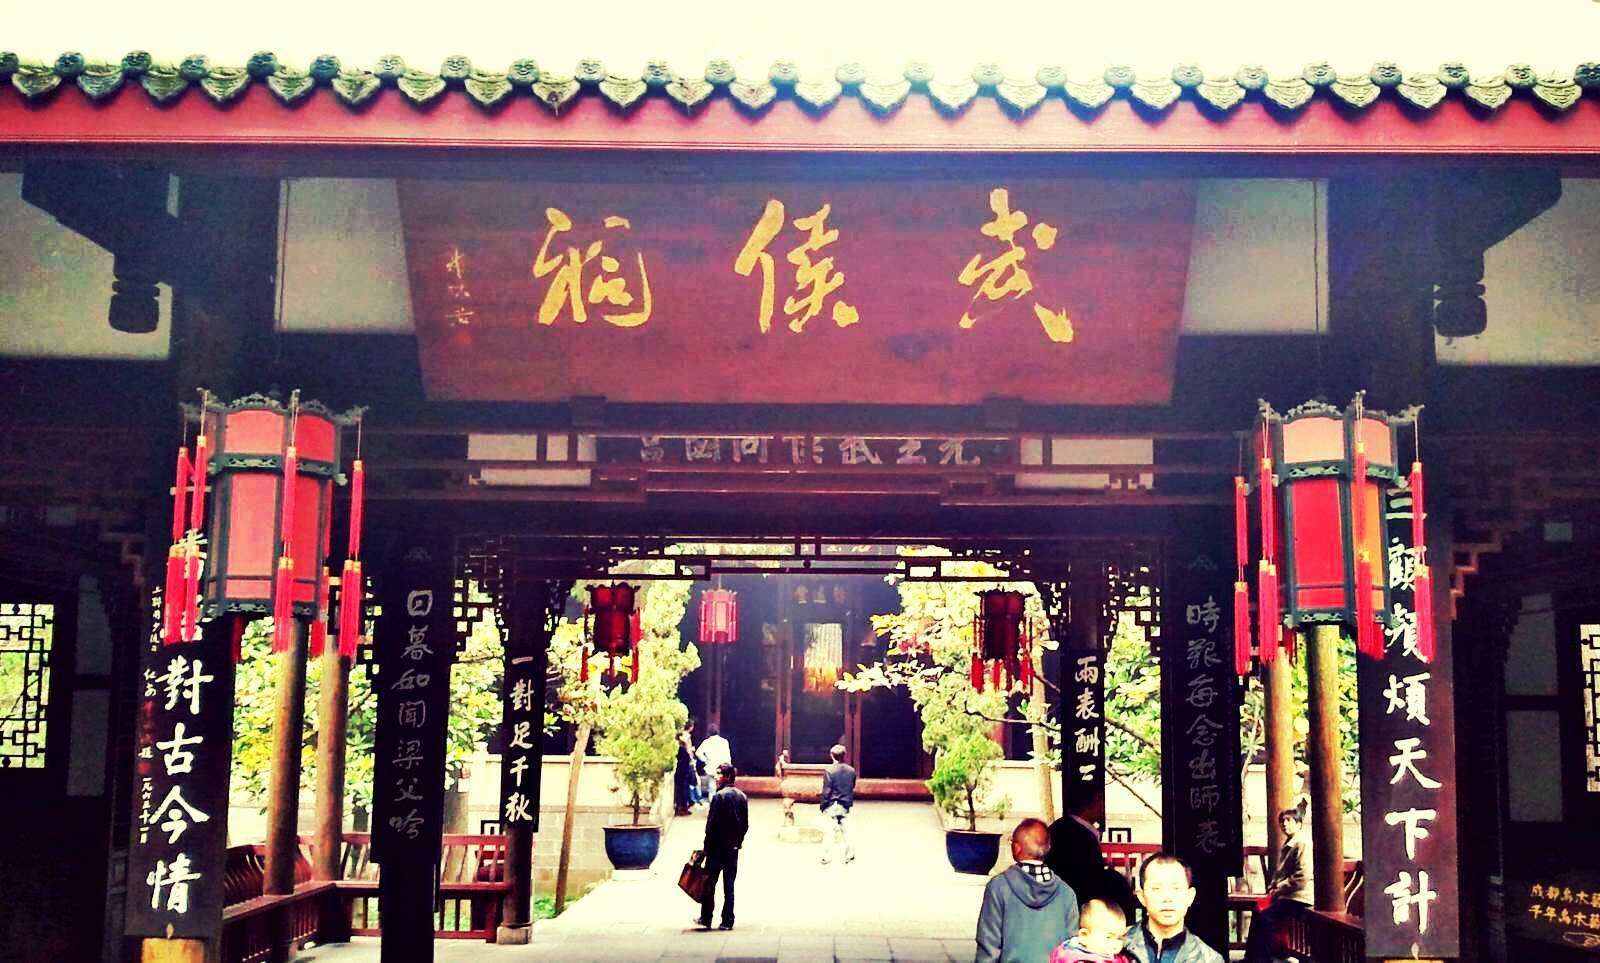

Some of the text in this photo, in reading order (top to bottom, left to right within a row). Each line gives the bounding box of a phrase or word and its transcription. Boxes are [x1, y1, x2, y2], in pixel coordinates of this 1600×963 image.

[505, 656, 534, 823] 一對足千秋
